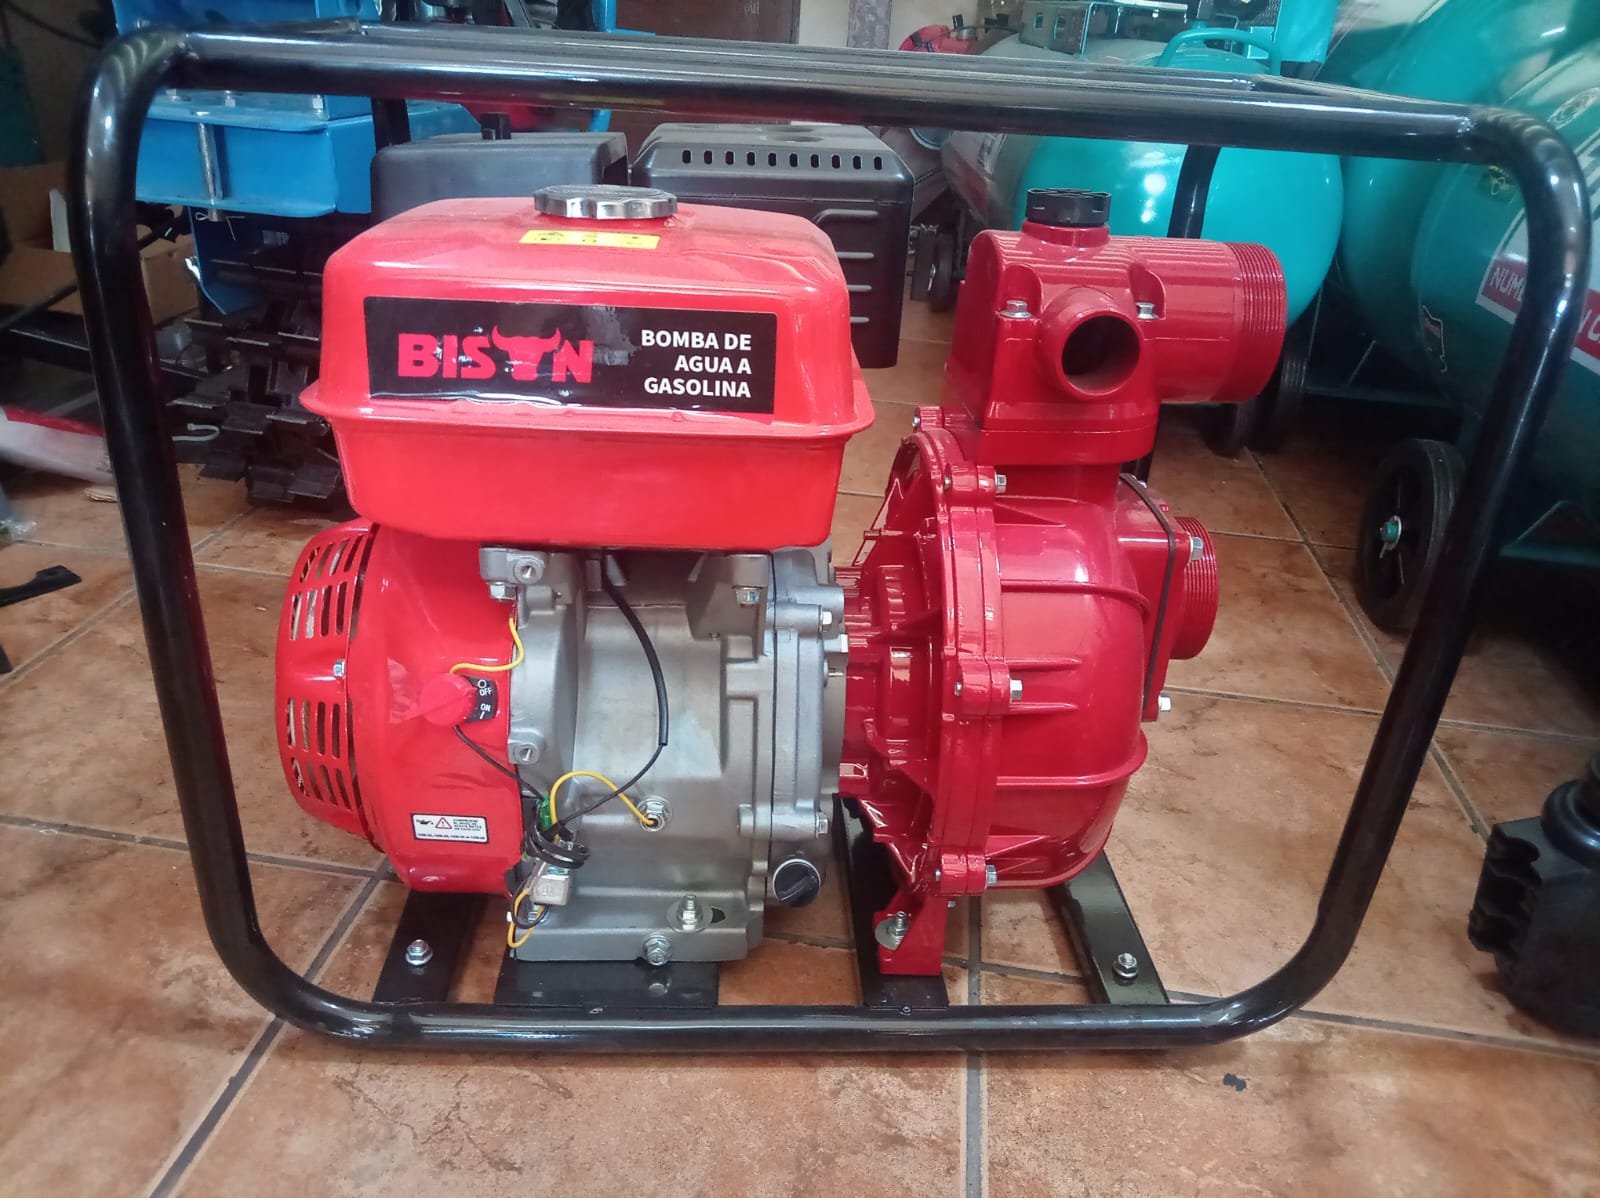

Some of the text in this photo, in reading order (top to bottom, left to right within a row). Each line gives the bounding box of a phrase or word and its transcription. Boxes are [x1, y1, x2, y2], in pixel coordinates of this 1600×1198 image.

[641, 329, 752, 351] BOMBA DE
[674, 354, 752, 375] AGUA A
[643, 377, 752, 398] GASOLINA
[479, 687, 493, 696] OFF
[480, 703, 492, 712] ON
